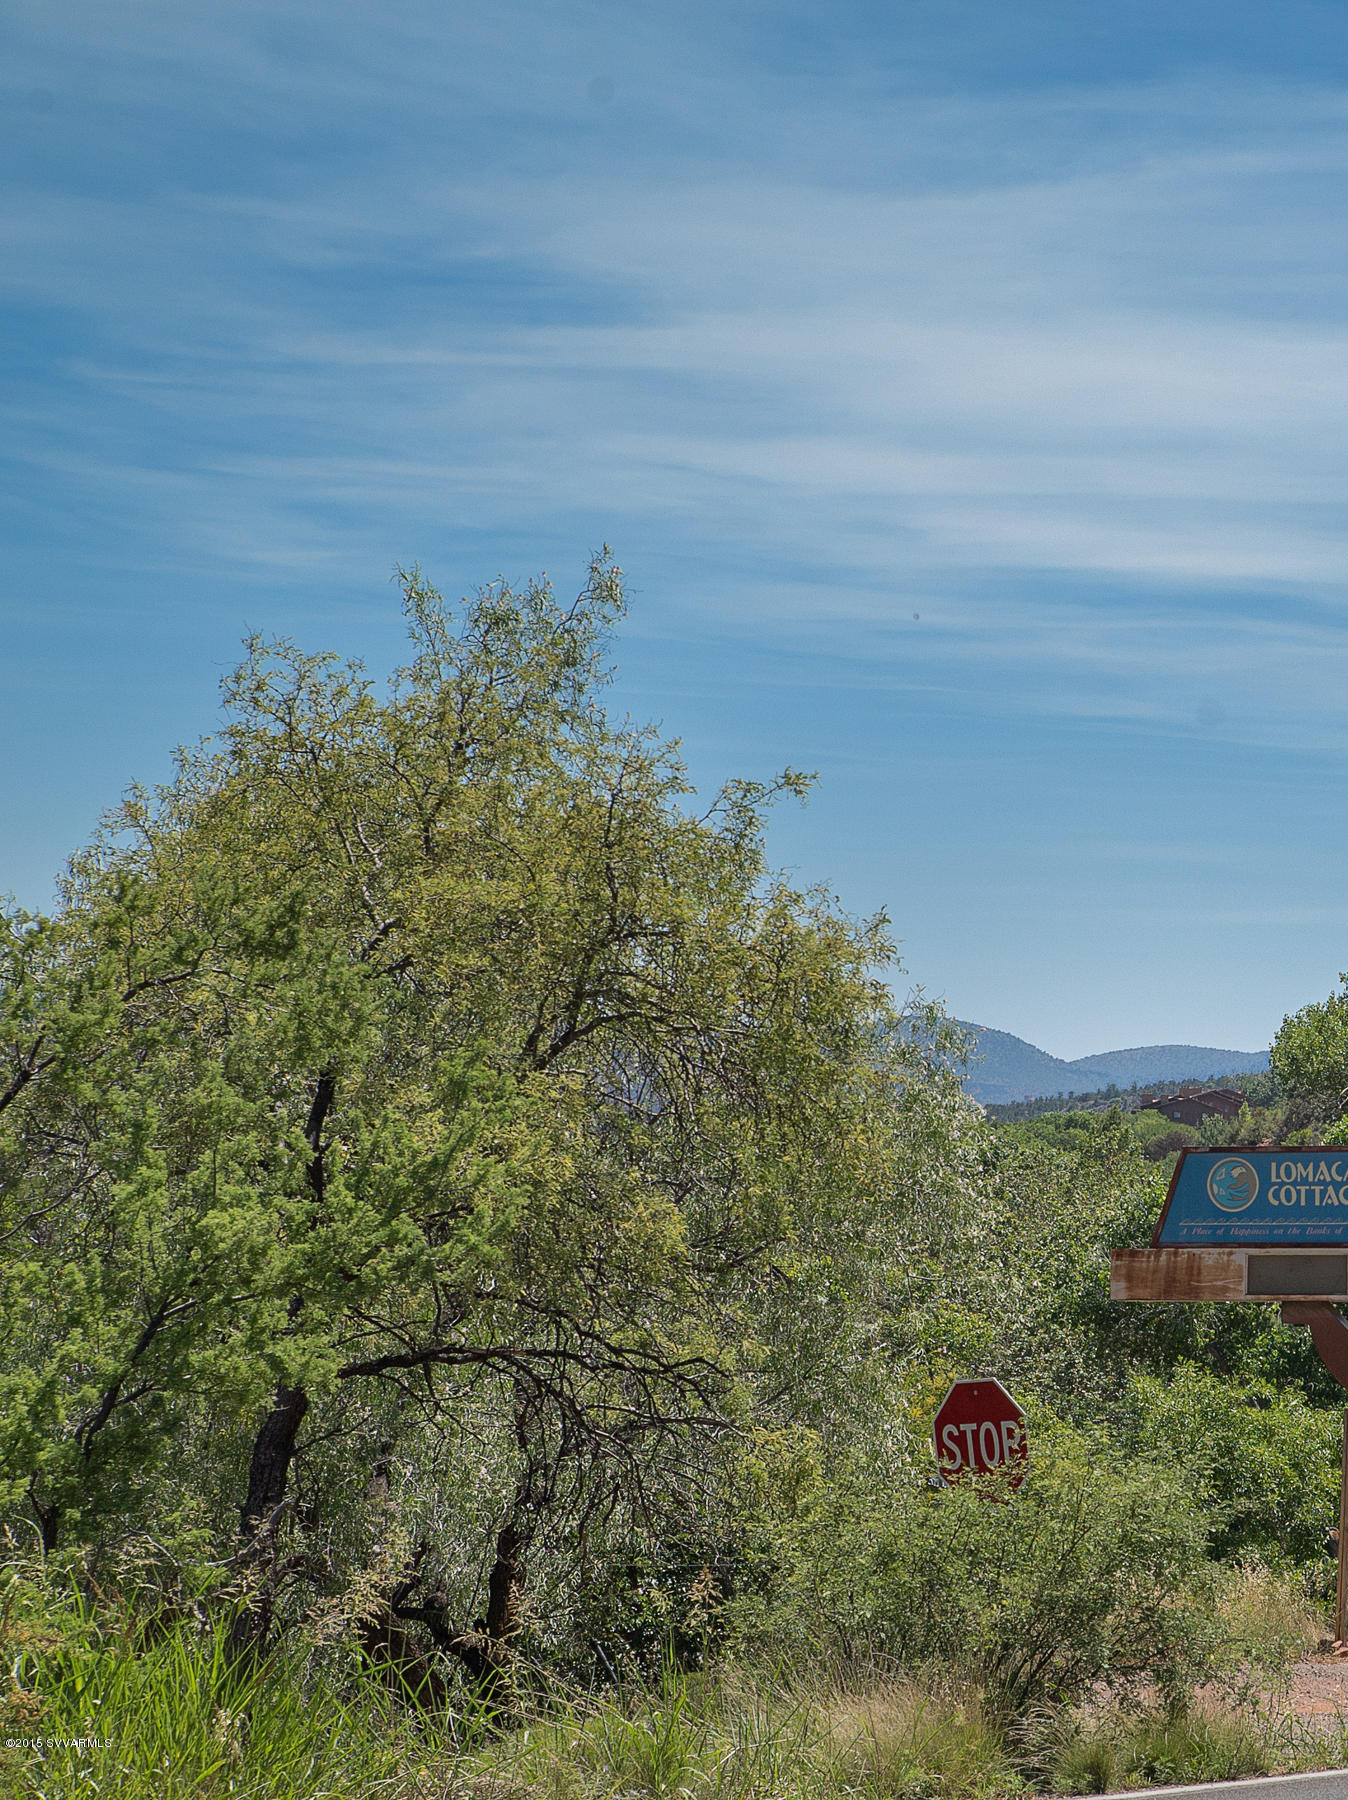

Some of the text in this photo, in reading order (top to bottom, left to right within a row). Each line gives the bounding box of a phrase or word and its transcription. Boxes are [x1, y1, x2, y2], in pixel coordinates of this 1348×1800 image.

[1192, 1227, 1211, 1235] Place
[1230, 1227, 1269, 1236] Happiness
[1287, 1227, 1301, 1235] the
[1305, 1227, 1330, 1235] Banks
[1334, 1227, 1343, 1235] of
[942, 1420, 1021, 1470] STOP
